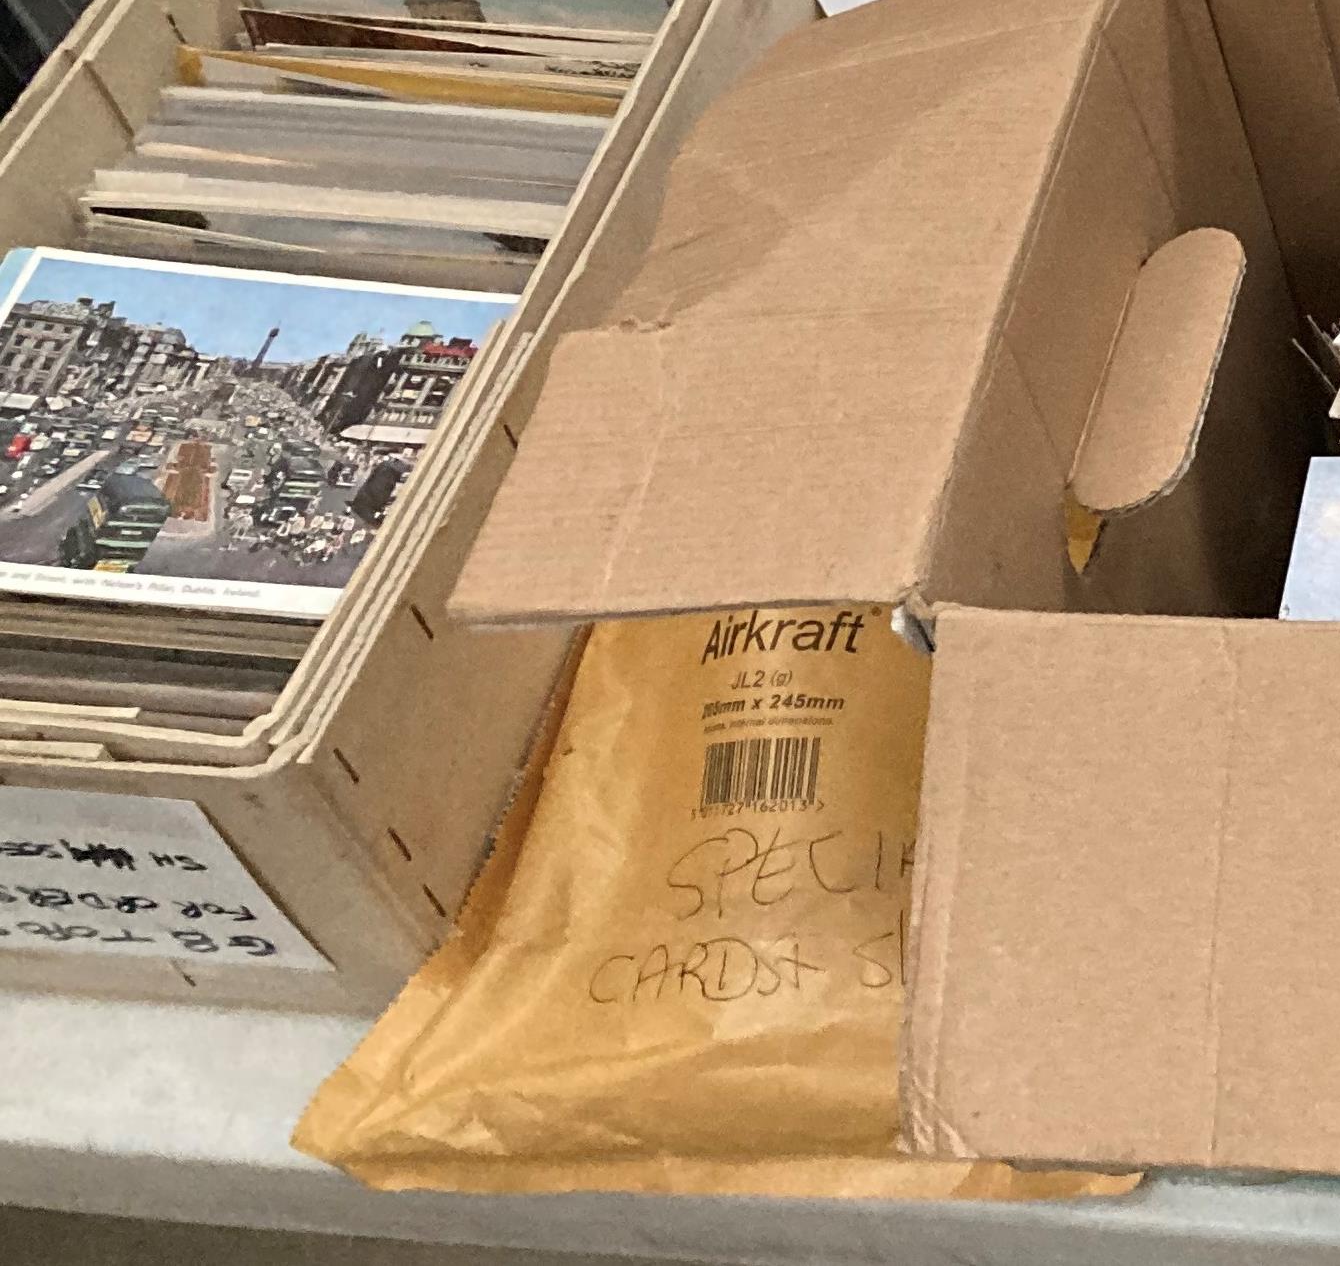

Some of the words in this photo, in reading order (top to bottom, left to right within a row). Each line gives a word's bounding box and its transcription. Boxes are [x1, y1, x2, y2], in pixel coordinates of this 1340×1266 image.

[701, 610, 866, 665] Airkraft
[731, 670, 766, 690] JL2
[770, 669, 794, 688] (g)
[751, 698, 762, 710] x
[769, 694, 845, 711] 245mm
